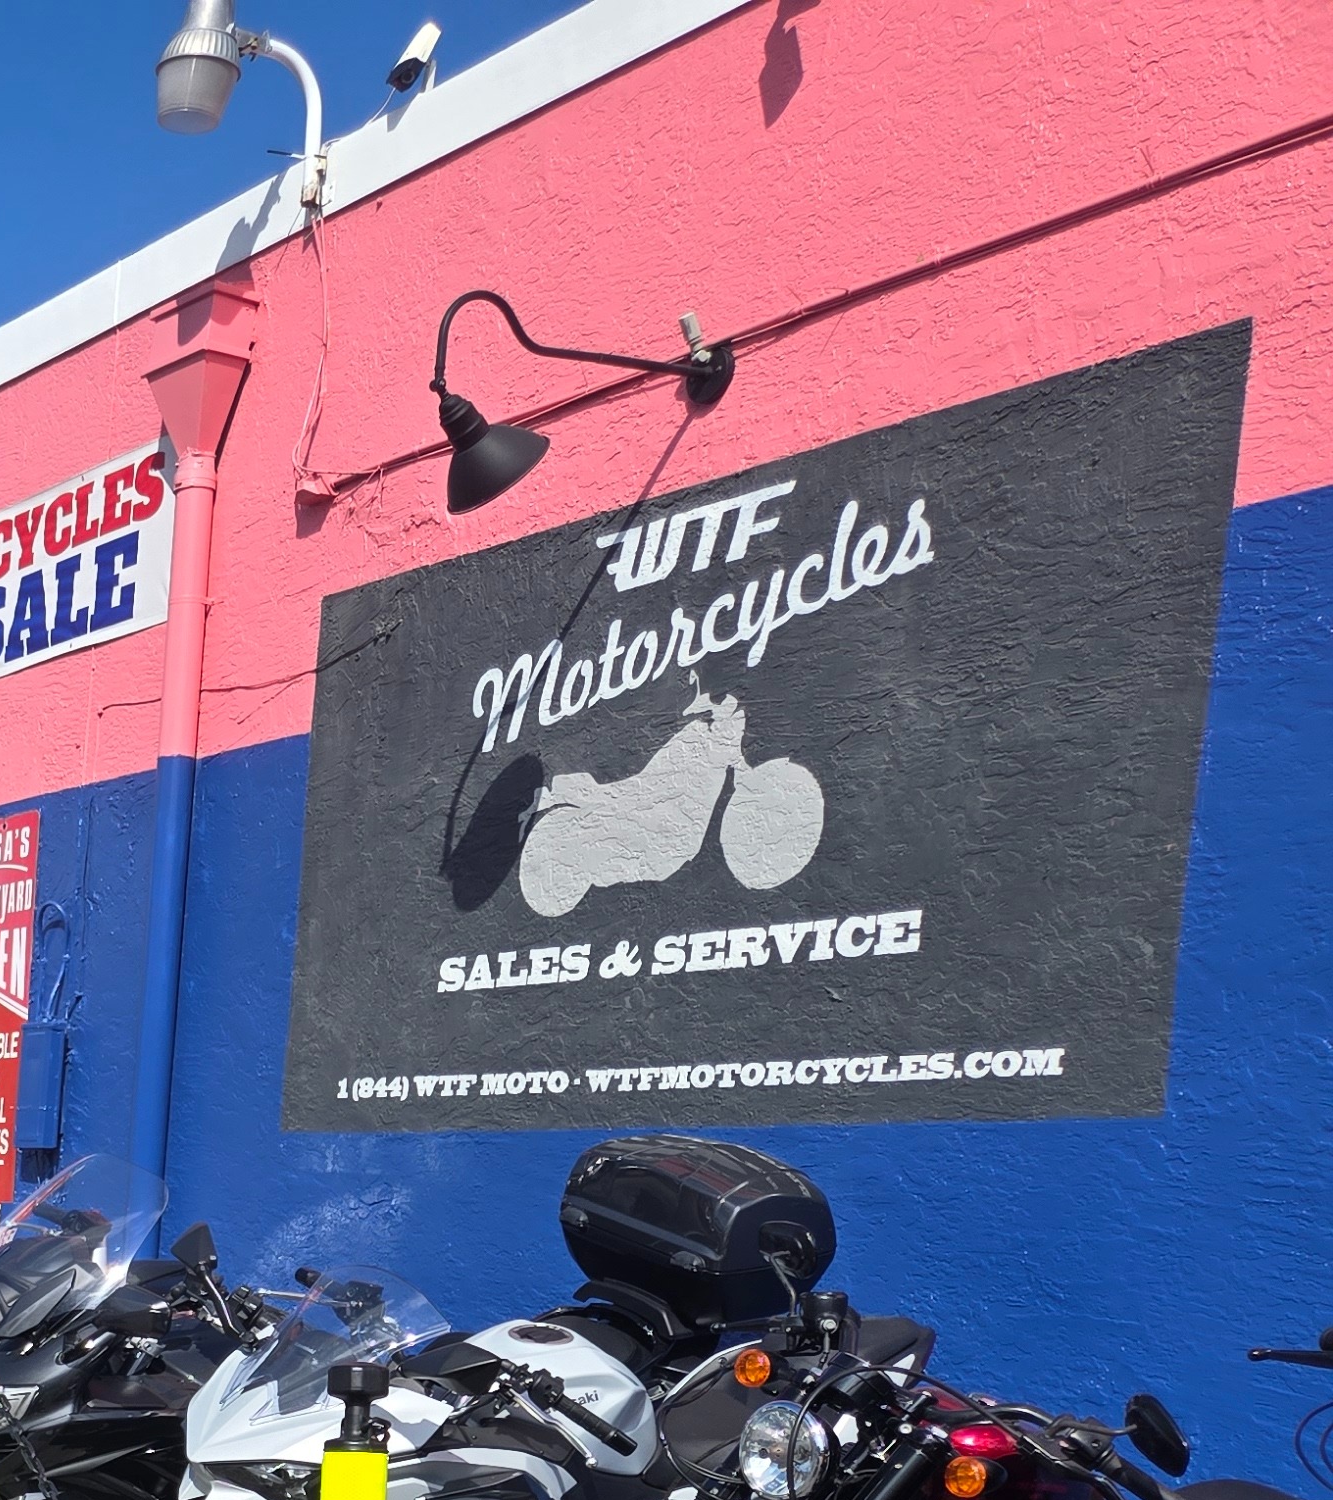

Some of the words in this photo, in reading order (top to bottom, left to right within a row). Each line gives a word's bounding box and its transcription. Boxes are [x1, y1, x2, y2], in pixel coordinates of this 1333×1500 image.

[596, 480, 797, 592] WTF
[472, 498, 934, 754] Motorcycles
[436, 941, 591, 994] SALES
[595, 941, 643, 978] &
[650, 909, 923, 977] SERVICE
[352, 1075, 410, 1101] (844)
[413, 1072, 478, 1098] WTF
[479, 1069, 571, 1097] MOTO
[585, 1048, 1065, 1094] WTFMOTORCYCLES.COM
